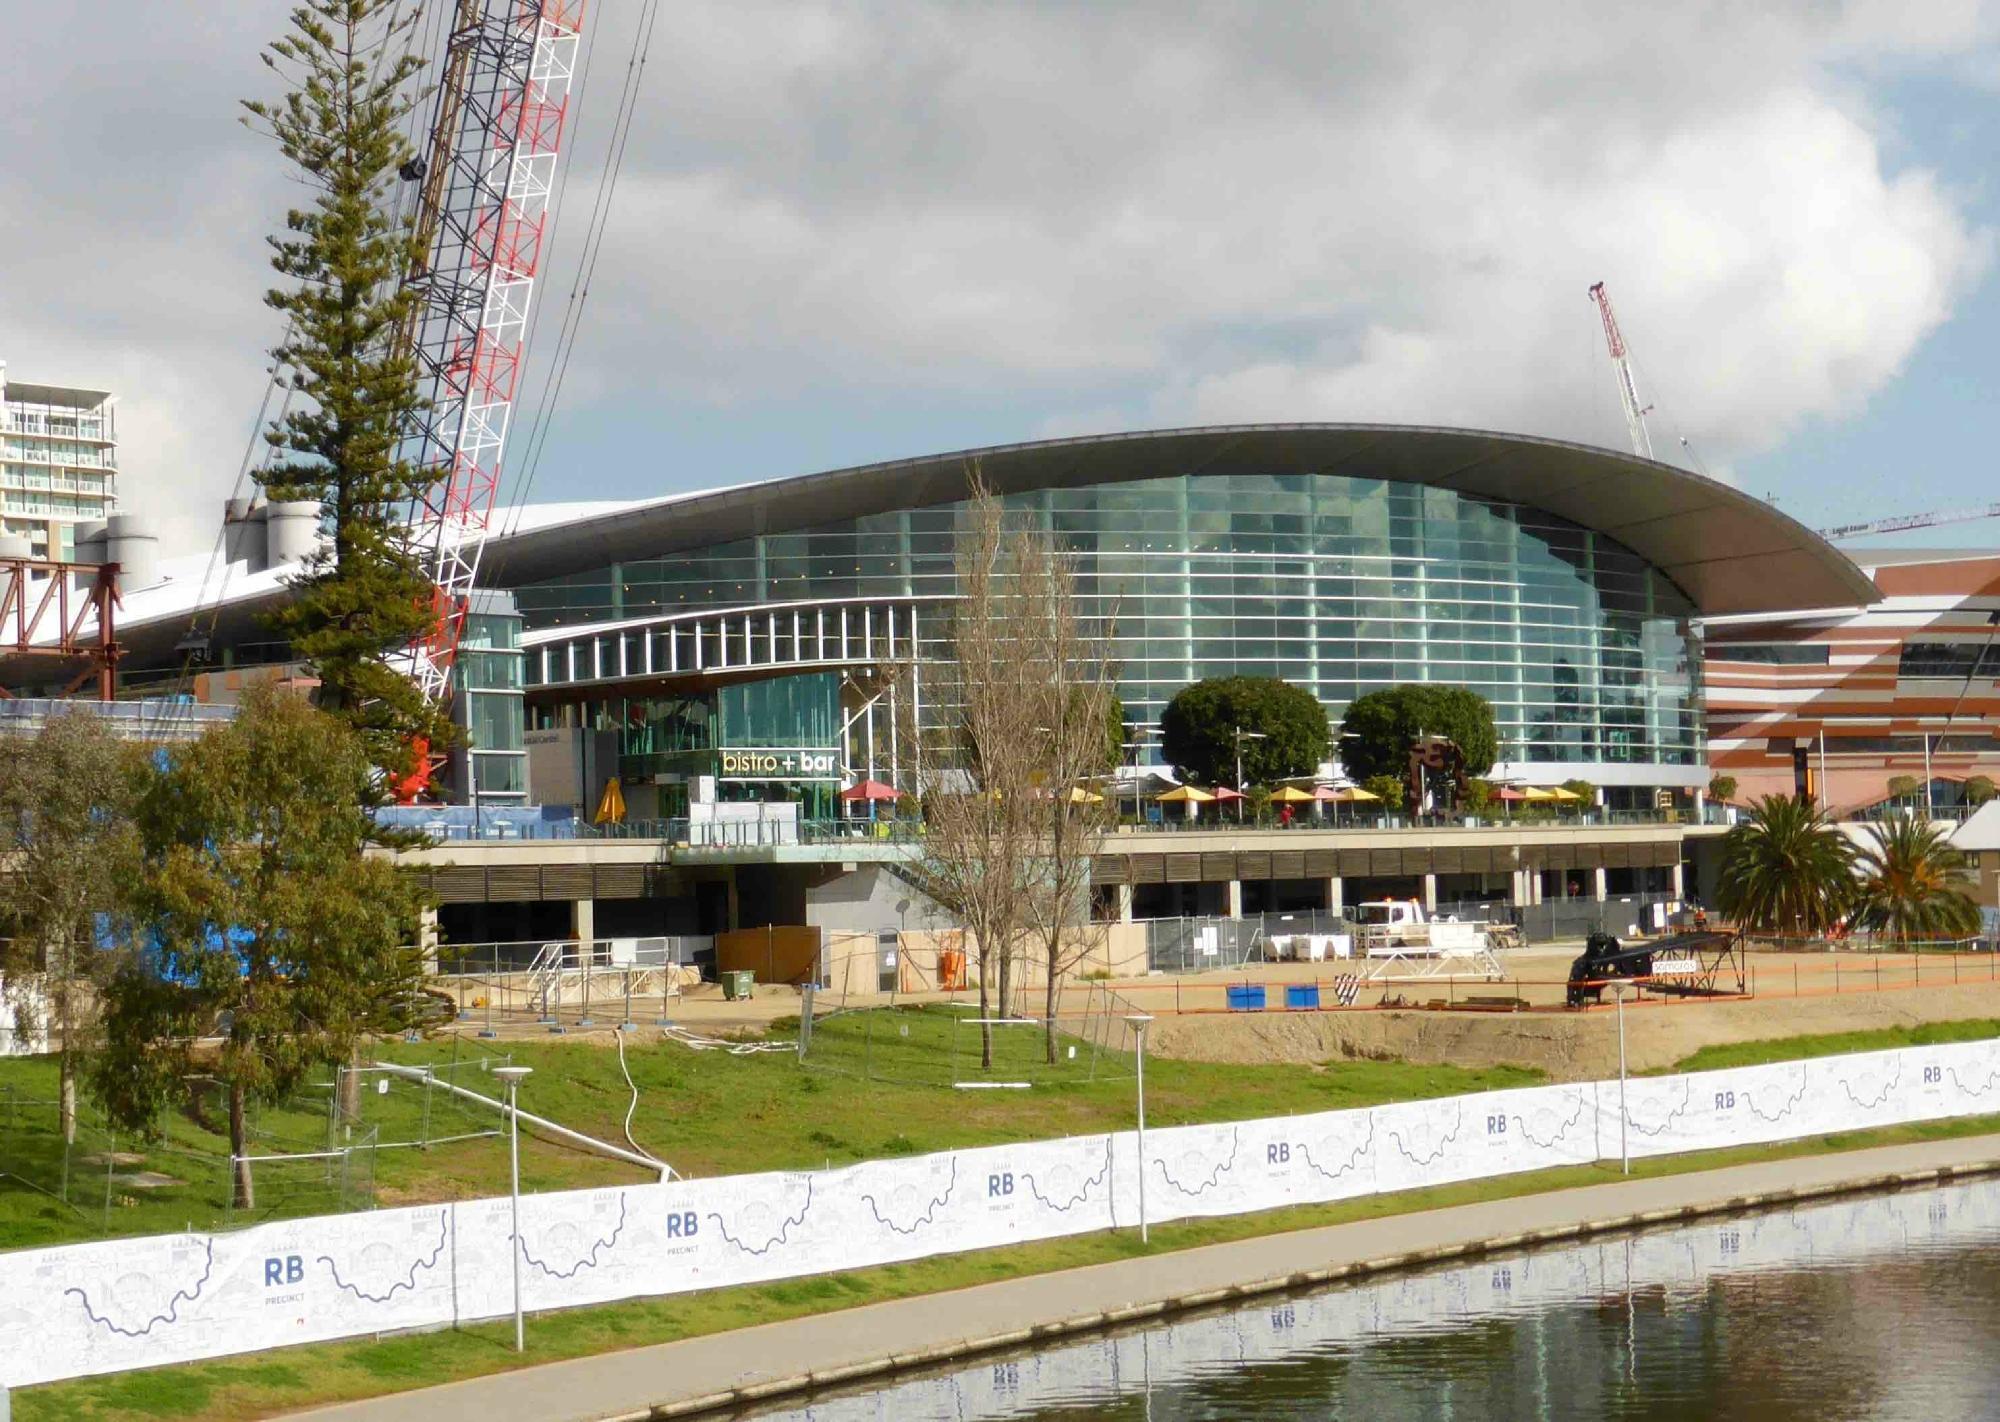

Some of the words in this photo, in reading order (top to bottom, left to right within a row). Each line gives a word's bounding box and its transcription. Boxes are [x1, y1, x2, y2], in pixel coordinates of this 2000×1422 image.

[723, 752, 777, 772] bistro
[801, 752, 835, 772] bar
[1924, 1066, 1941, 1084] RB
[1715, 1091, 1735, 1110] RB
[1487, 1115, 1507, 1134] RB
[1267, 1142, 1290, 1164] RB
[988, 1172, 1014, 1197] RB
[667, 1211, 698, 1238] RB
[265, 1255, 304, 1287] RB
[265, 1293, 304, 1305] PRECINCT
